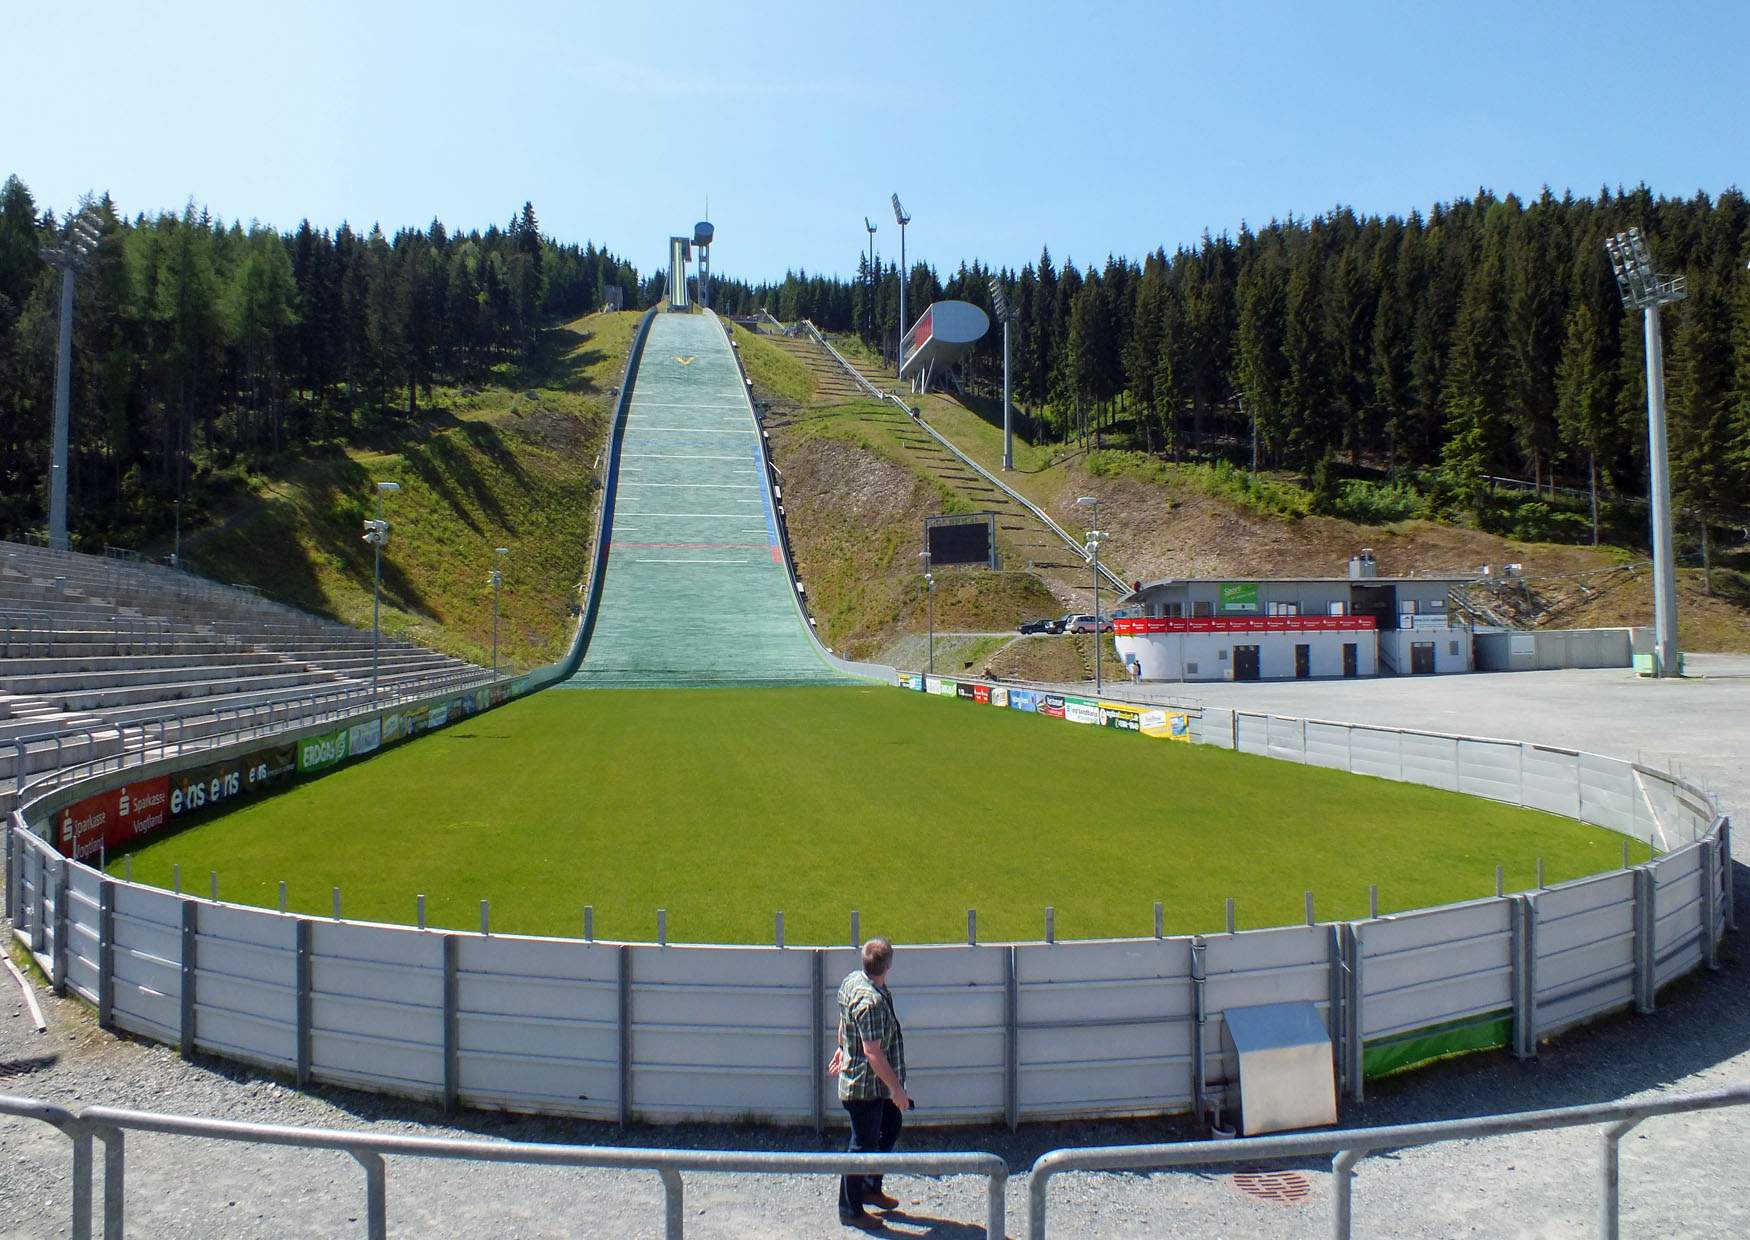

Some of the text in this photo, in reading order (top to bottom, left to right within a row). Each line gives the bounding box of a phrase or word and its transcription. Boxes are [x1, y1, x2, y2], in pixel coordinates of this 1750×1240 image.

[303, 740, 336, 768] ERDGAS
[133, 792, 165, 813] Sparkasse
[75, 811, 106, 837] Sparkasse
[133, 810, 163, 833] Vogtland
